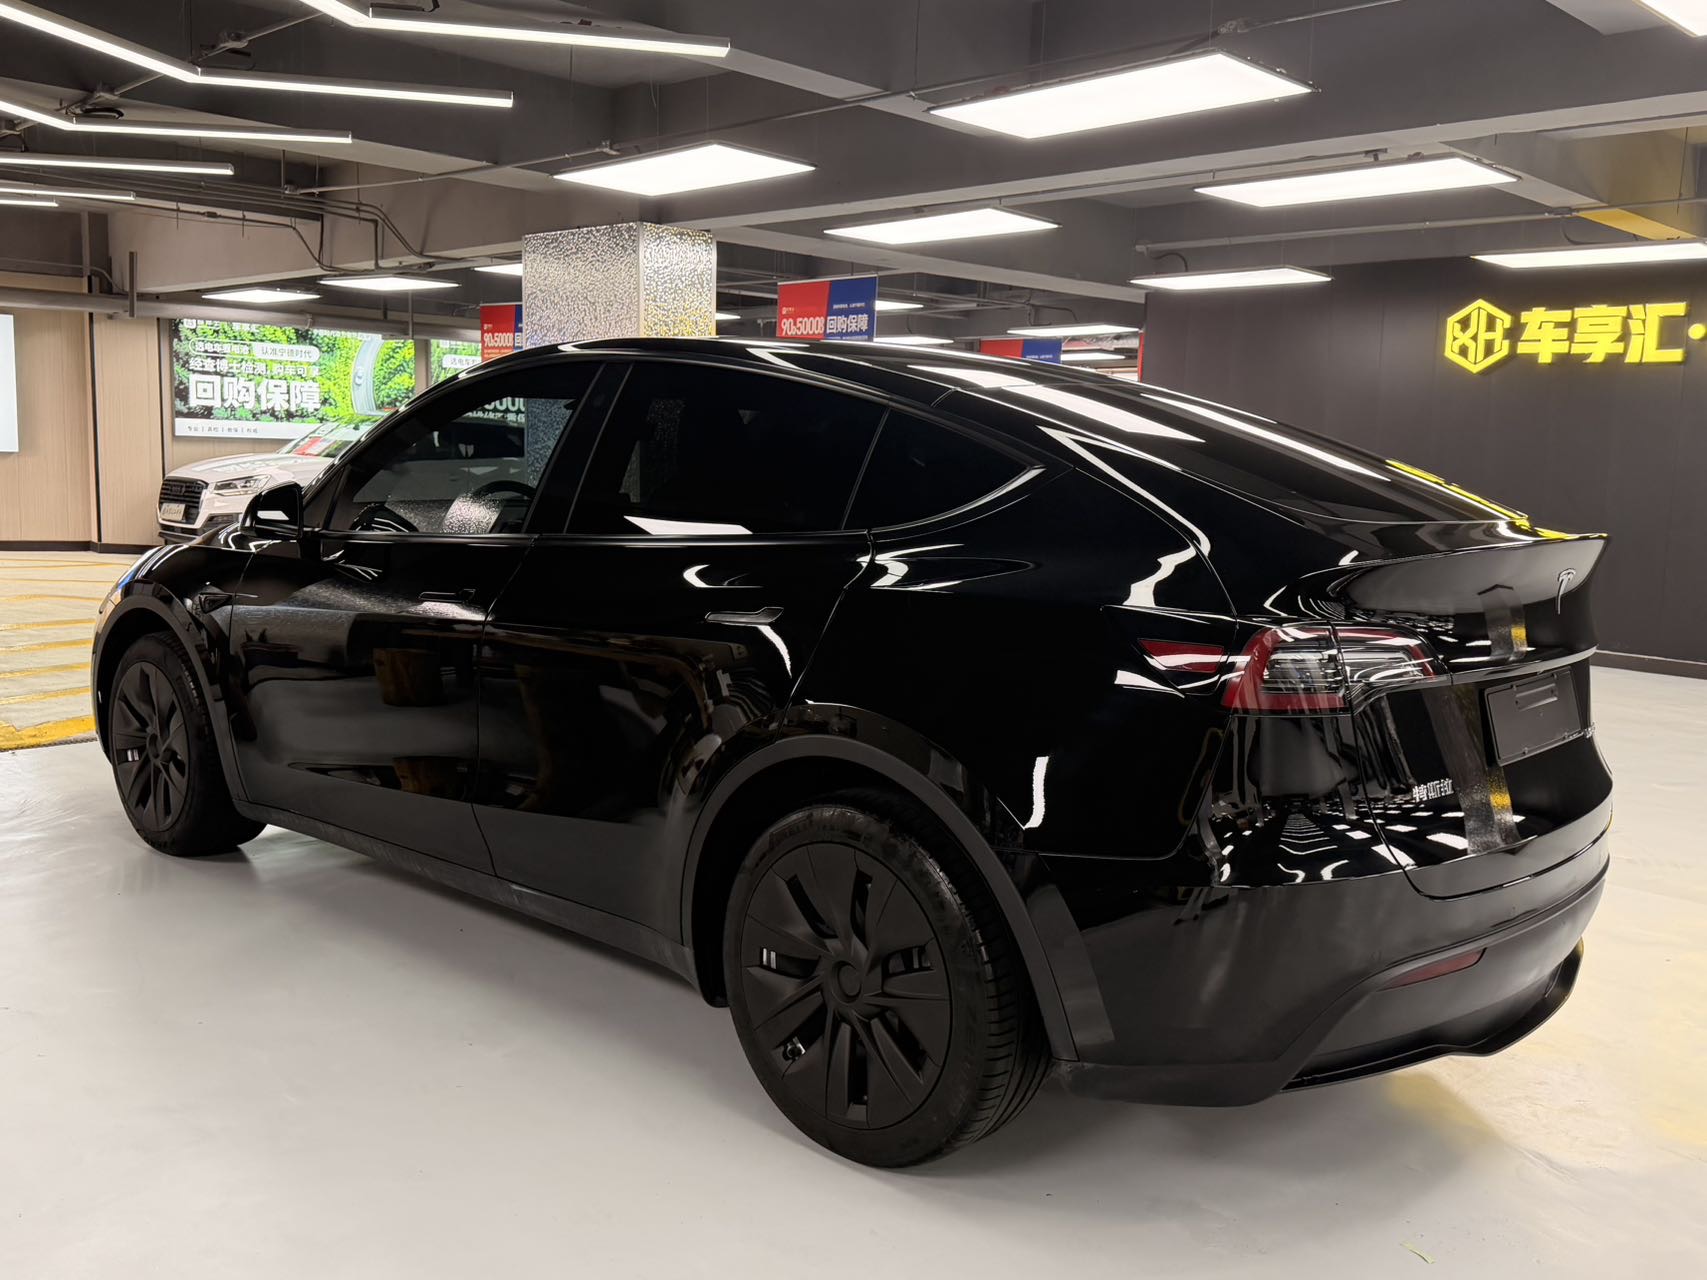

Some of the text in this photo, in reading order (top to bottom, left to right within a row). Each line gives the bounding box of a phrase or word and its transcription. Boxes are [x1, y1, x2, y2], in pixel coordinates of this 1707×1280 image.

[826, 313, 868, 333] 回购保障
[261, 346, 313, 359] 认准宁德时代
[188, 373, 322, 412] 回购保障
[1412, 778, 1454, 802] 特斯拉
